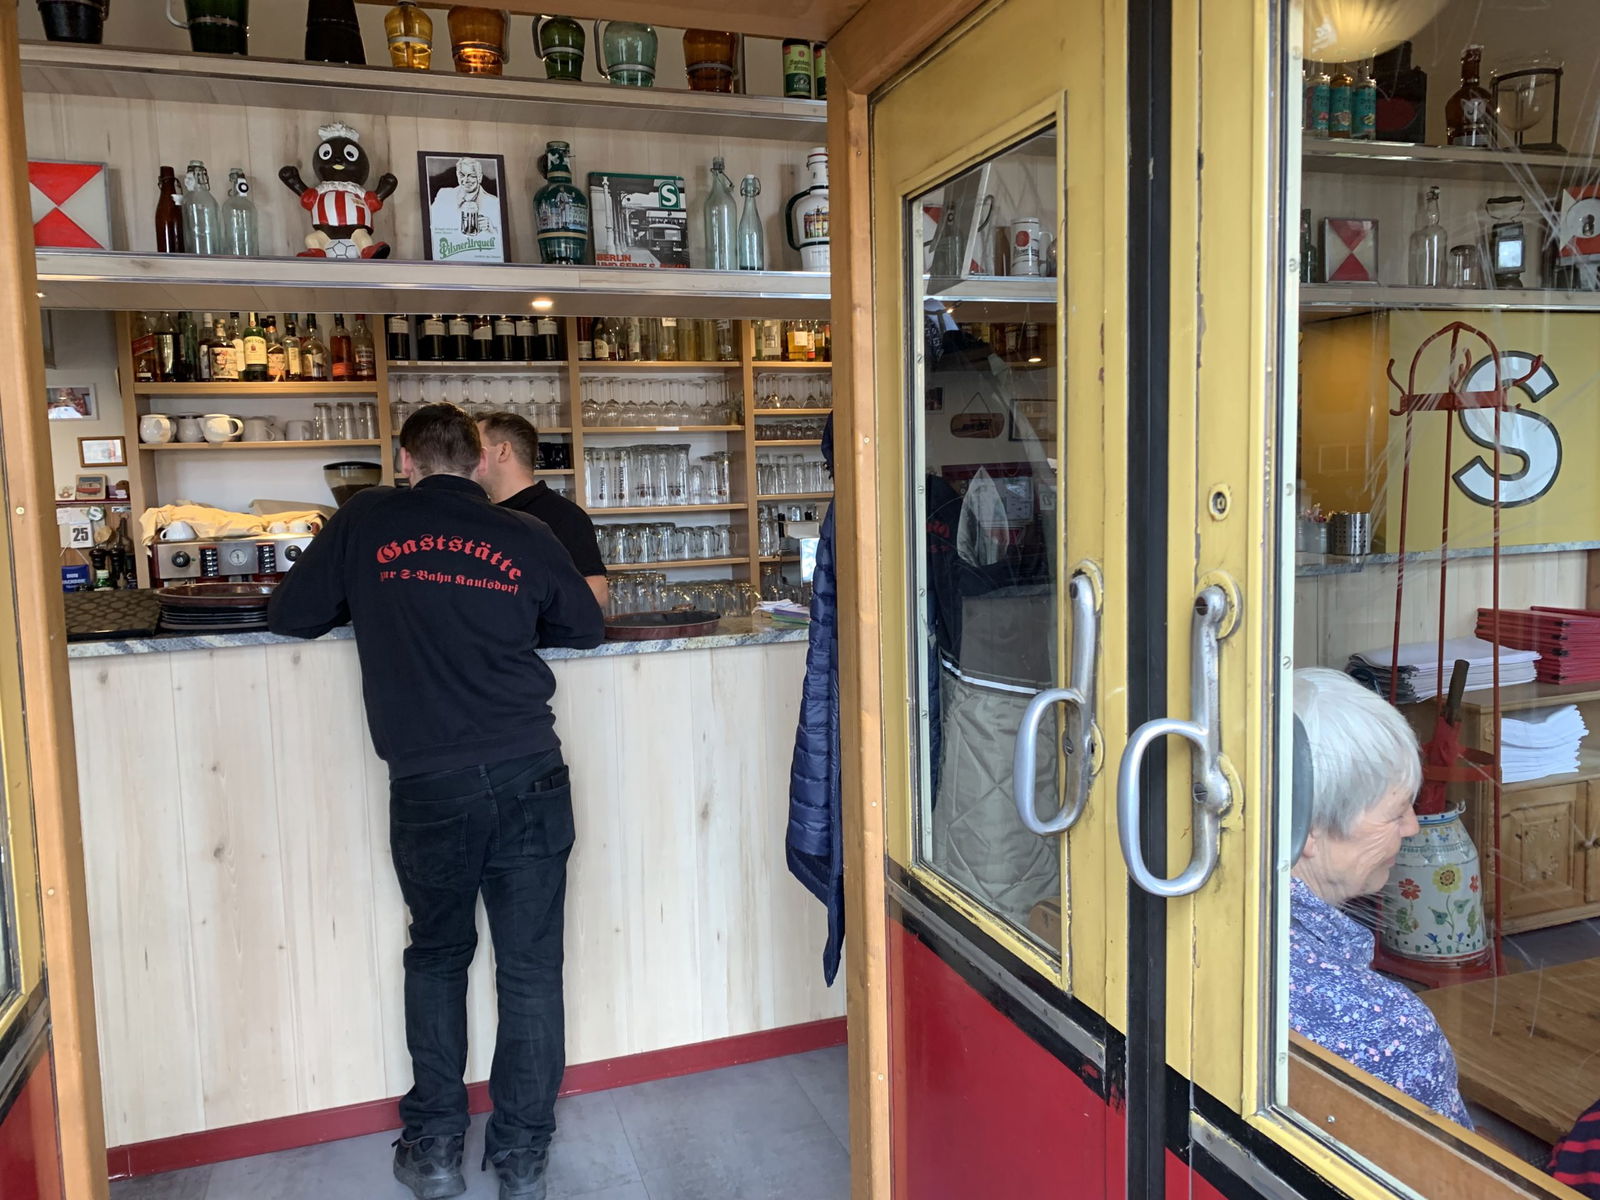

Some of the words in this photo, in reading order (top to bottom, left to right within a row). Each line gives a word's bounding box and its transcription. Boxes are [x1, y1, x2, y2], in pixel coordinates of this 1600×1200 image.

[661, 184, 677, 206] S
[596, 253, 632, 262] BERLIN
[1452, 350, 1563, 508] S
[72, 527, 89, 542] 25
[376, 533, 522, 581] Gaststätte
[399, 568, 452, 584] S-Bahn
[455, 574, 519, 596] Kaulsdorf
